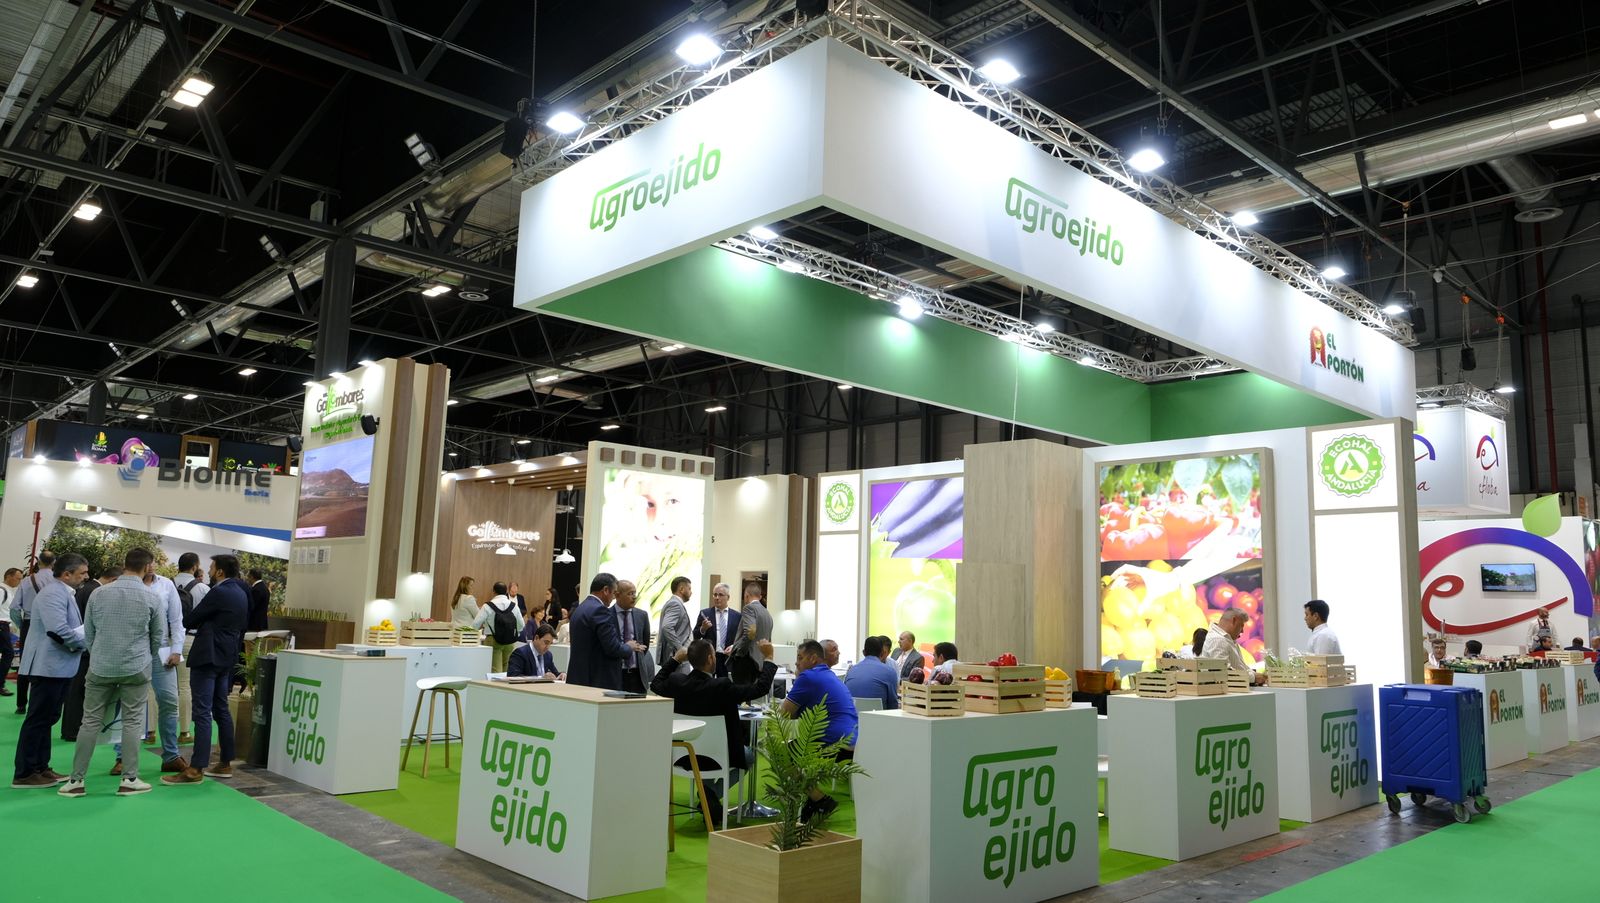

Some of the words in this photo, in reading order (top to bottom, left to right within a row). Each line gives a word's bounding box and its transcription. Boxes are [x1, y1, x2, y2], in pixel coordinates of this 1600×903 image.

[1326, 333, 1336, 350] EL
[1327, 354, 1364, 382] PORTÓN
[1329, 440, 1372, 458] ECOHAL
[158, 458, 271, 488] Bioline
[1499, 690, 1506, 703] EL
[1547, 683, 1553, 695] EL
[286, 722, 326, 765] ejido
[1330, 748, 1369, 799] ejido
[1208, 770, 1265, 831] ejido
[490, 787, 568, 853] ejido
[983, 806, 1076, 889] ejido
